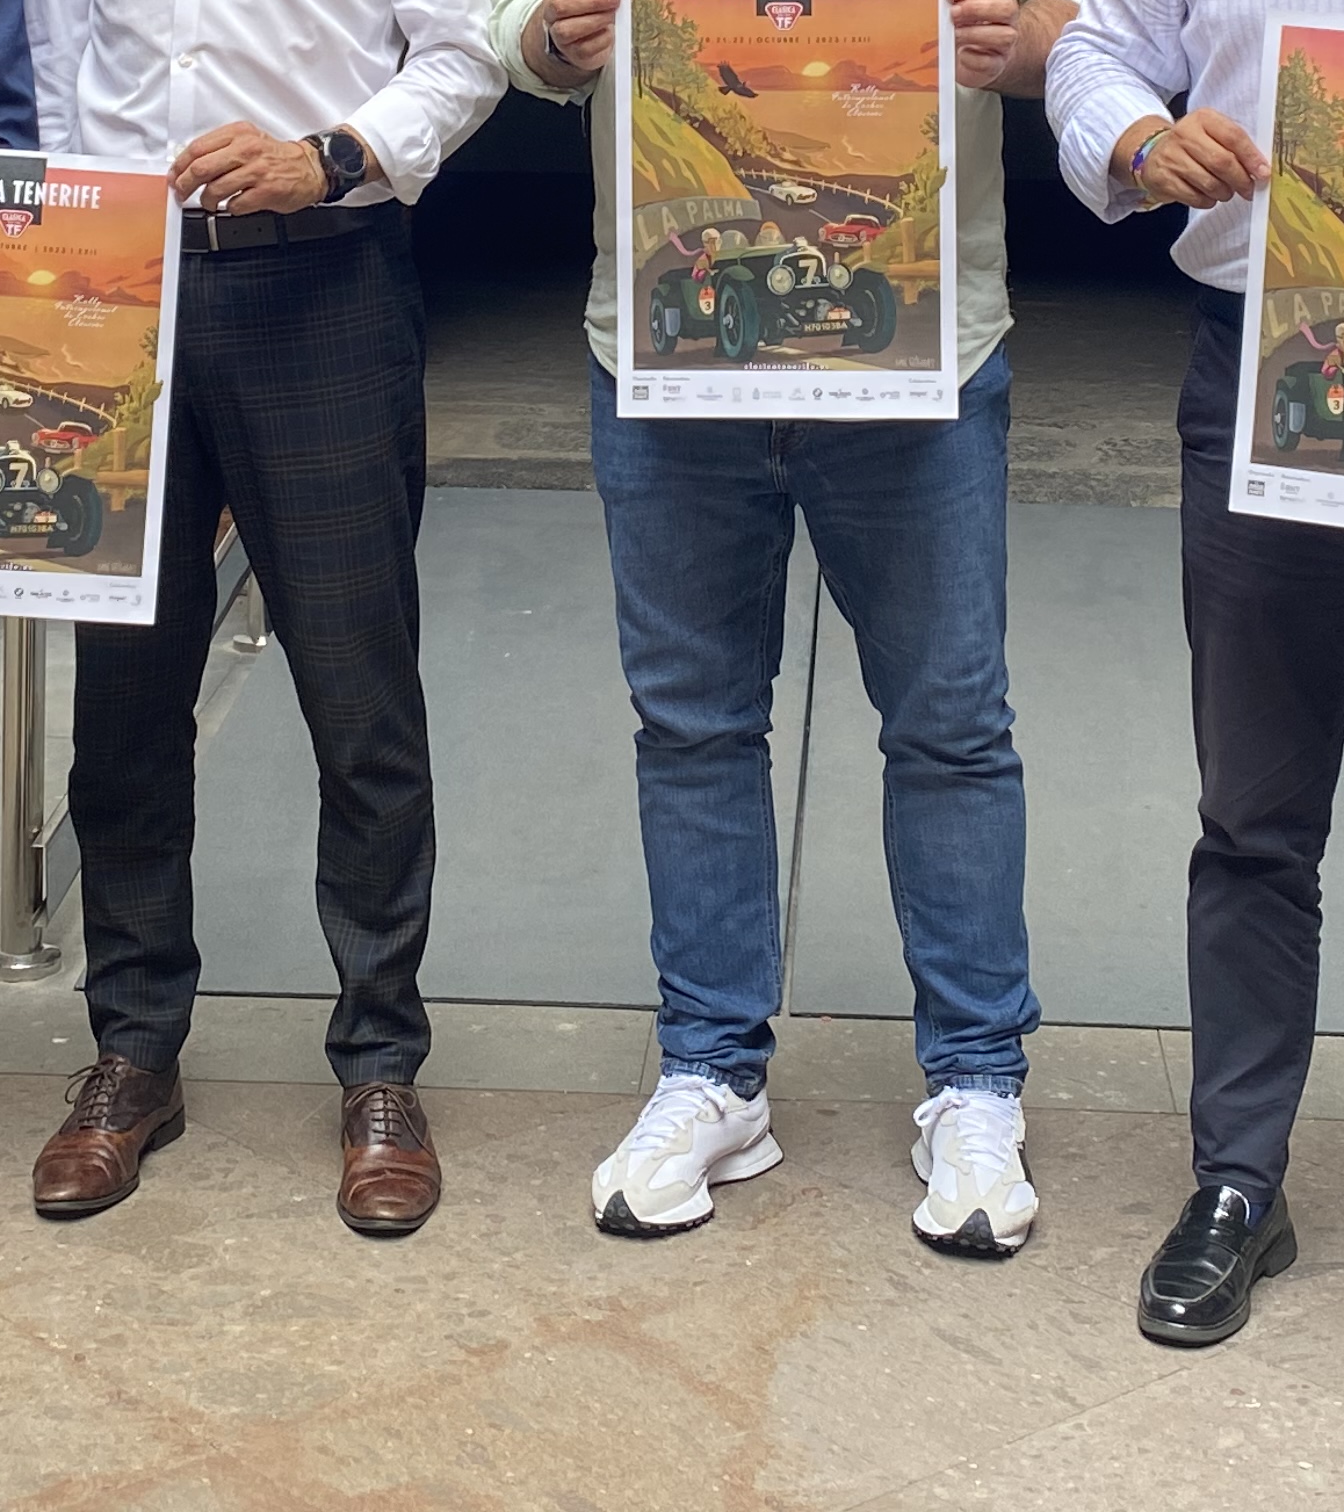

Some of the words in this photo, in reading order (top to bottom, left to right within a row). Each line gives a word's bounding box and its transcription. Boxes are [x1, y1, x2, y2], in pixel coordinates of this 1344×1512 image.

[776, 17, 793, 28] TF
[757, 36, 800, 44] OCTUBRE
[13, 180, 102, 209] TENERIFE
[6, 224, 22, 236] TF
[637, 206, 679, 250] LA
[686, 199, 744, 224] PALMA
[798, 259, 818, 287] 7
[704, 301, 711, 310] 3
[1266, 293, 1311, 338] LA
[1333, 400, 1340, 410] 3
[9, 462, 29, 489] 7
